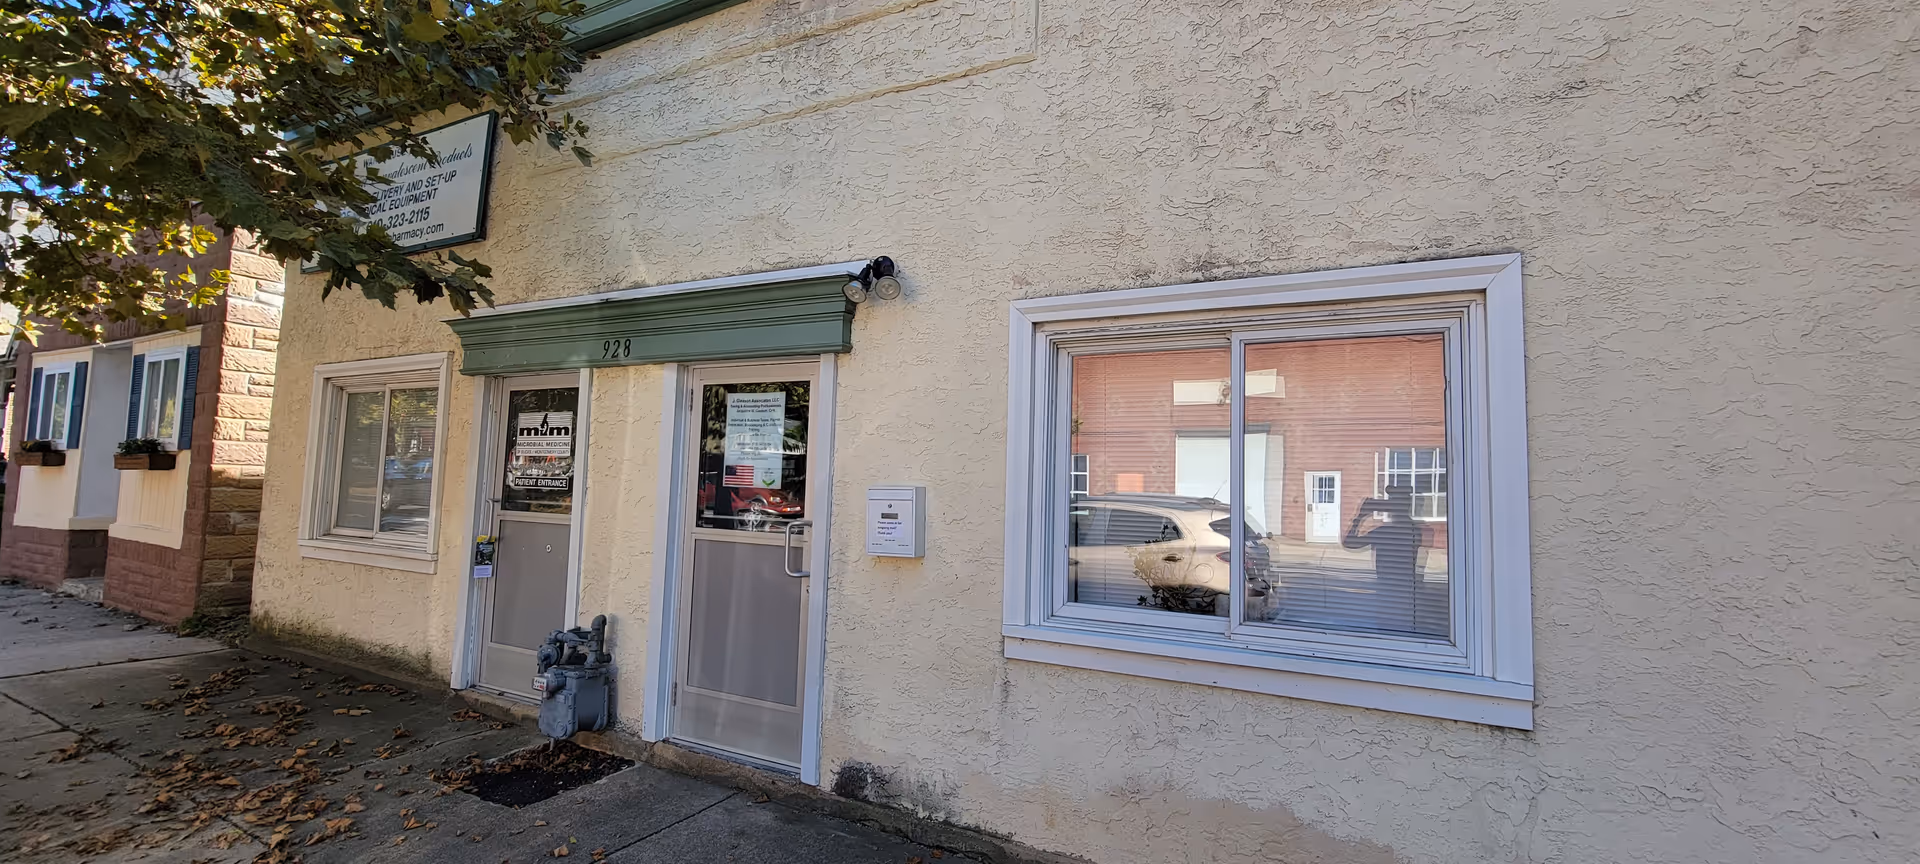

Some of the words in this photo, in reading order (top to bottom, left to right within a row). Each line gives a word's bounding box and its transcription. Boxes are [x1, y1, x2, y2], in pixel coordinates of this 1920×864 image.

[372, 184, 405, 202] ELIVERY
[405, 180, 423, 194] AND
[424, 170, 457, 188] SET-UP
[365, 203, 386, 217] DICAL
[388, 187, 438, 211] EQUIPMENT
[391, 222, 444, 243] harmacy.com
[602, 338, 632, 360] 928
[515, 478, 536, 486] PATIENT
[537, 479, 567, 487] ENTRANCE
